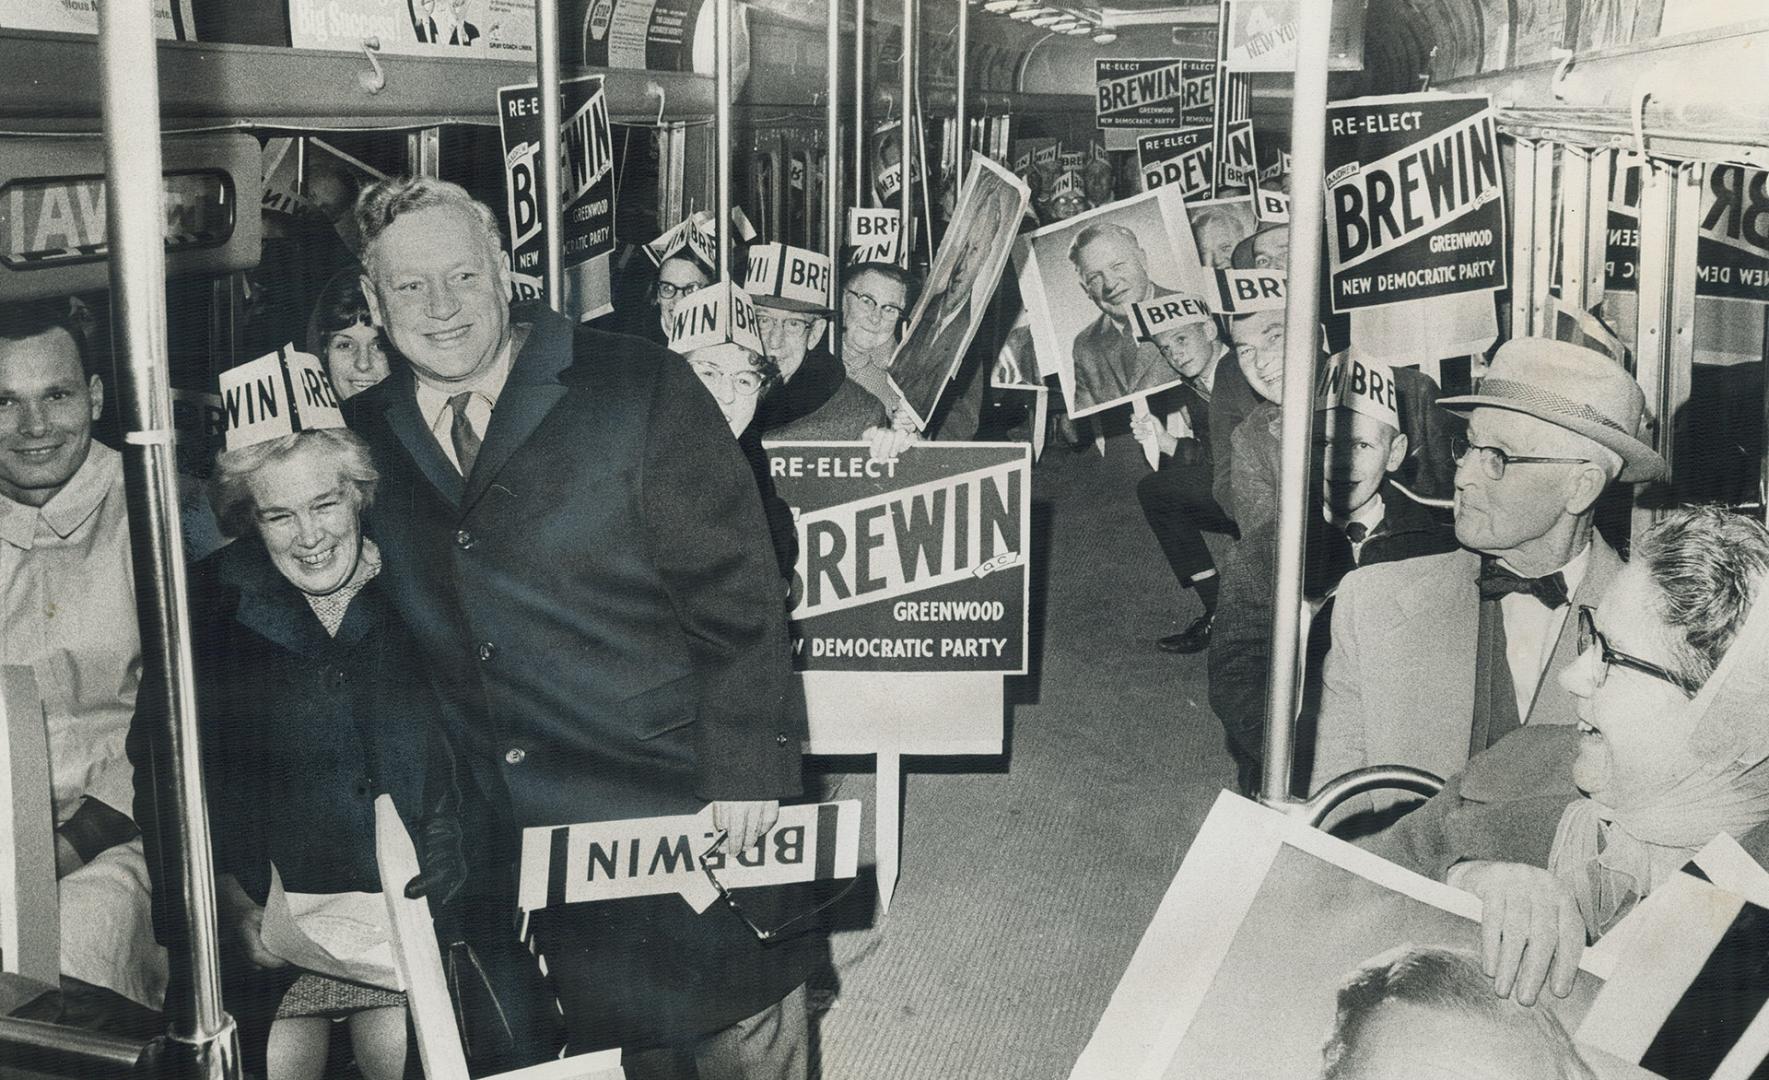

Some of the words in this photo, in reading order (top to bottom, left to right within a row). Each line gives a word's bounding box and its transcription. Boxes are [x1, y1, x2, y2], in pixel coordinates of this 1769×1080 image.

[1245, 33, 1274, 59] NEW
[1274, 22, 1297, 44] YO
[1100, 63, 1140, 71] RE-ELECT
[1183, 63, 1215, 71] E-ELECT
[1100, 65, 1180, 113] BREWIN
[1332, 110, 1422, 136] RE-ELECT
[1145, 134, 1199, 150] RE-ELECT
[1333, 115, 1496, 264] BREWIN
[572, 199, 608, 223] GREENWOOD
[519, 250, 539, 269] NEW
[590, 226, 610, 245] PARTY
[1430, 230, 1493, 254] GREENWOOD
[1342, 275, 1372, 296] NEW
[1377, 264, 1456, 293] DEMOCRATIC
[1459, 259, 1496, 281] PARTY
[672, 301, 718, 343] WIN
[221, 375, 278, 429] WIN
[770, 456, 899, 478] RE-ELECT
[893, 601, 1005, 622] GREENWOOD
[812, 638, 934, 658] DEMOCRATIC
[940, 638, 1008, 658] PARTY
